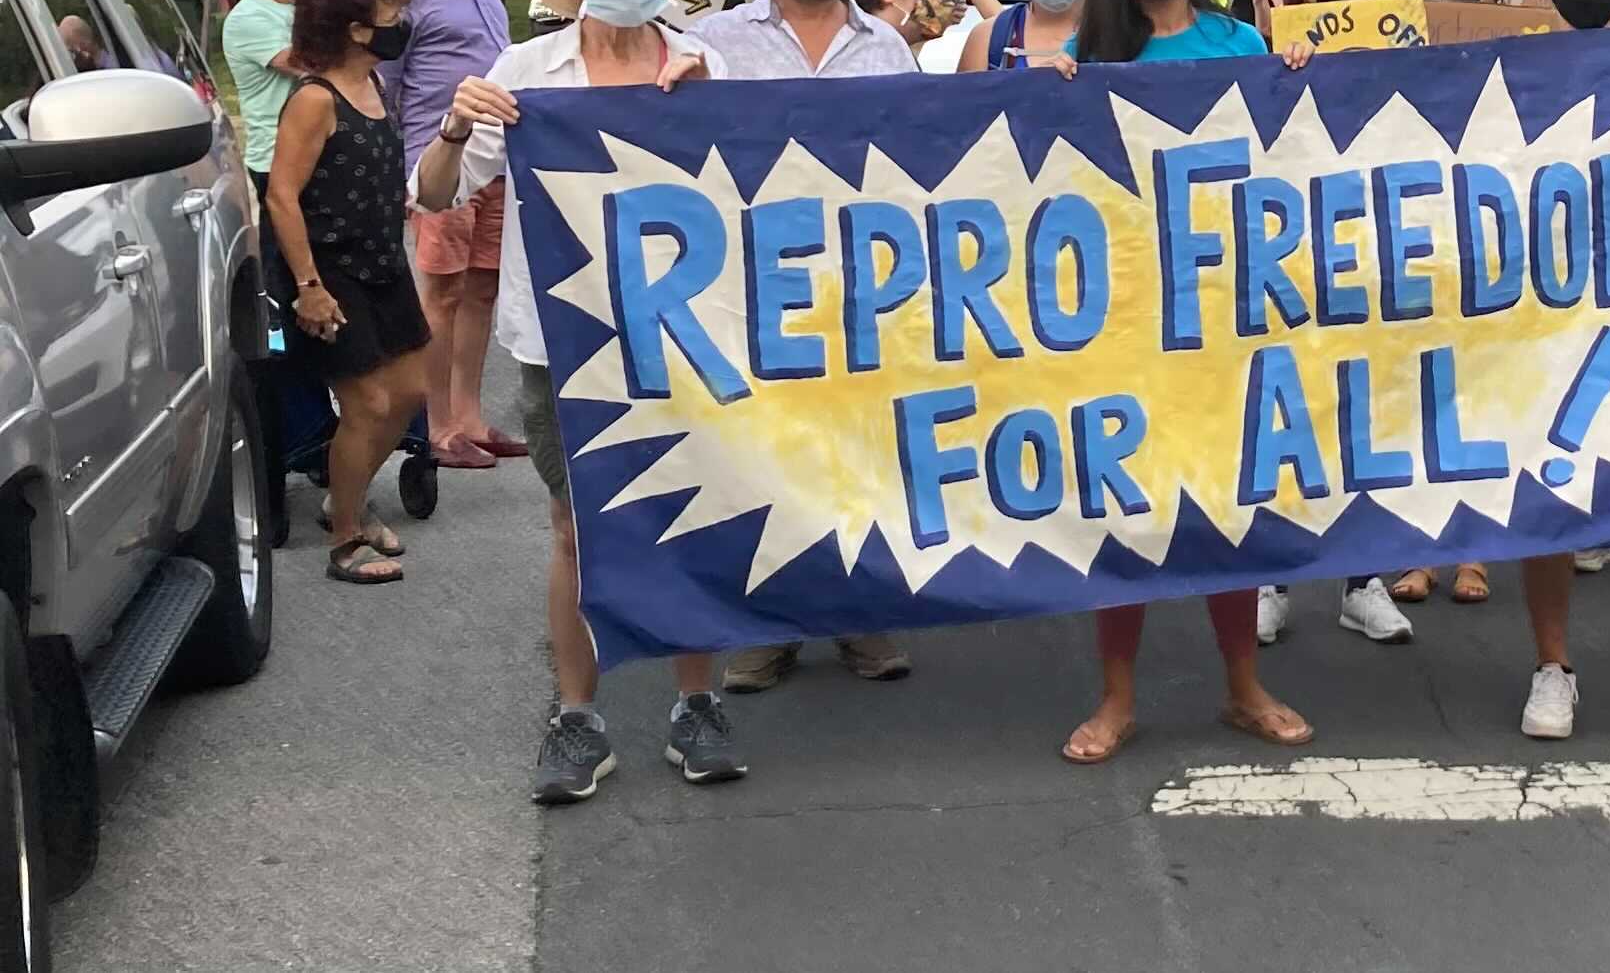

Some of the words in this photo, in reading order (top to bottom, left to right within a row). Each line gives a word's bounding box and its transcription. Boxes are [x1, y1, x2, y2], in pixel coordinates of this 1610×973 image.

[1306, 7, 1355, 46] NDS
[603, 181, 1111, 405] REPRO
[893, 384, 1152, 549] FOR
